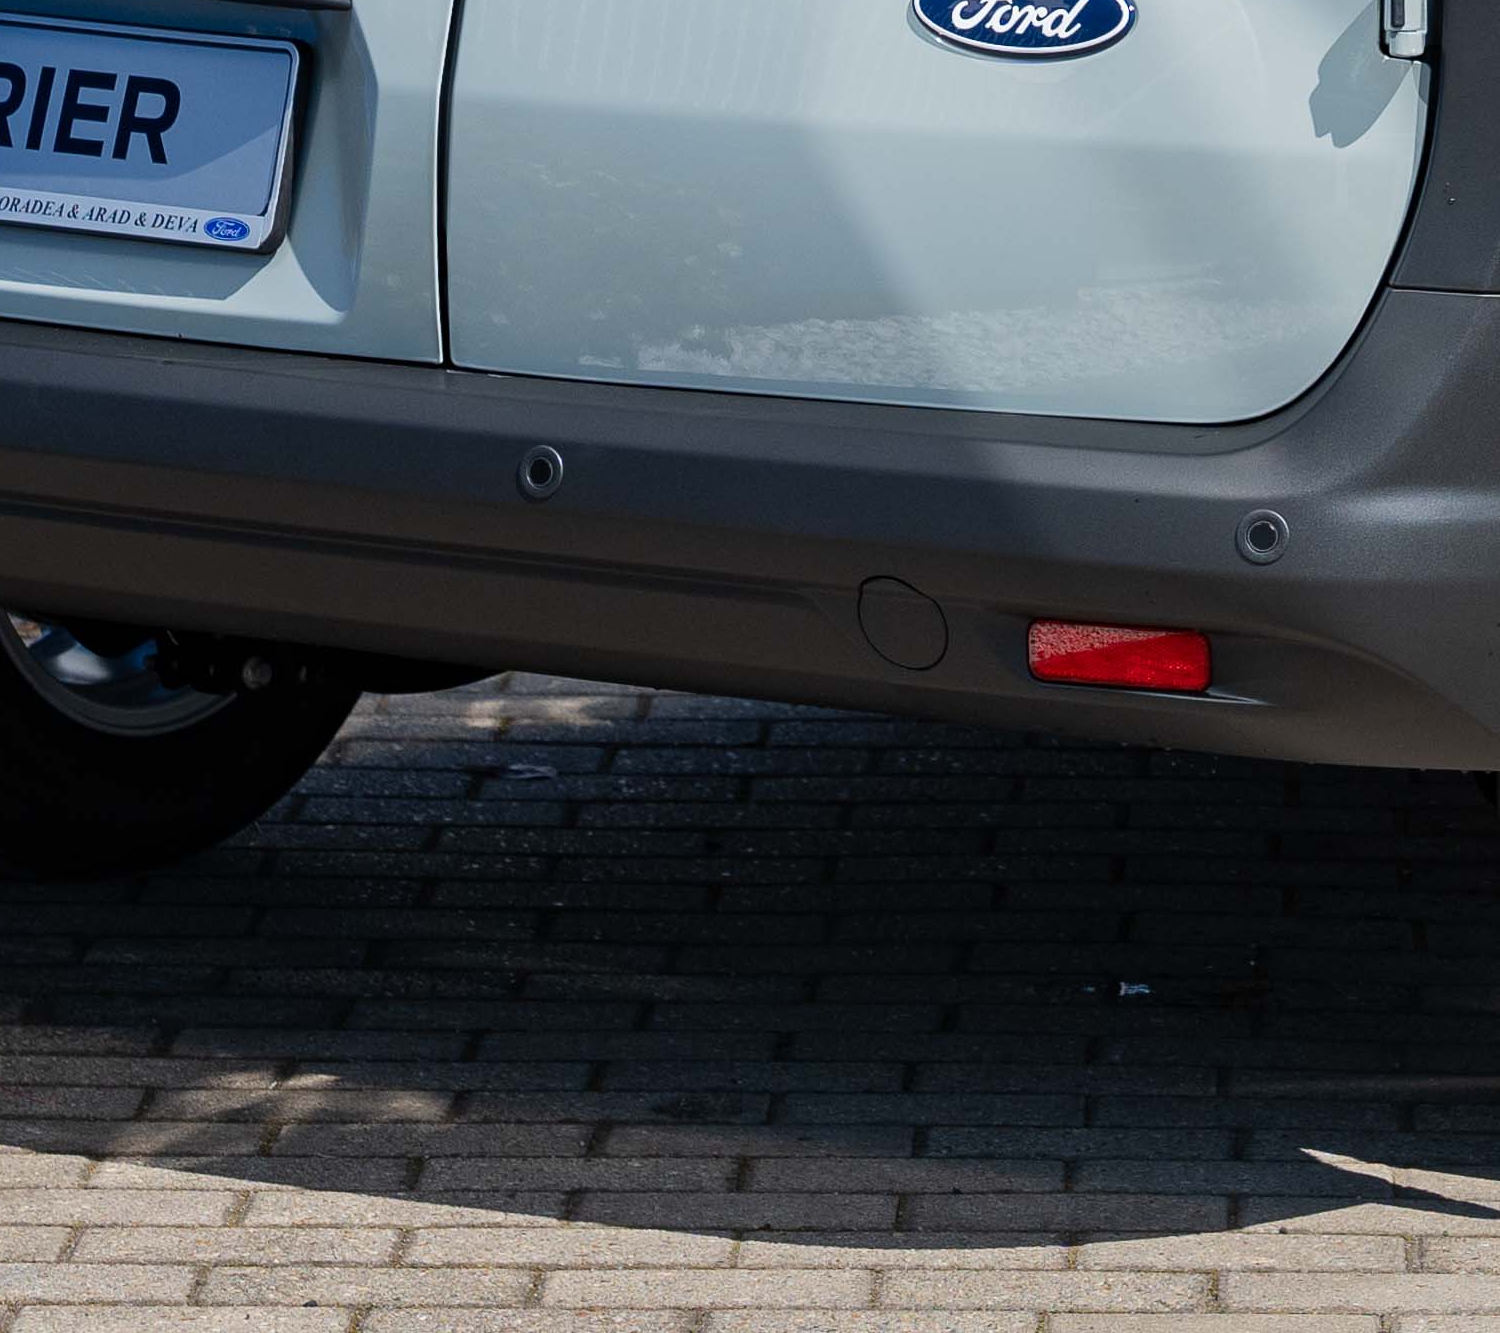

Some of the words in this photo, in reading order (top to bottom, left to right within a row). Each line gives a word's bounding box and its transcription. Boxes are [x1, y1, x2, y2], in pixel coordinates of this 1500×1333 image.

[67, 203, 80, 220] &
[82, 206, 132, 226] ARAD
[134, 211, 148, 228] &
[151, 213, 199, 234] DEVA
